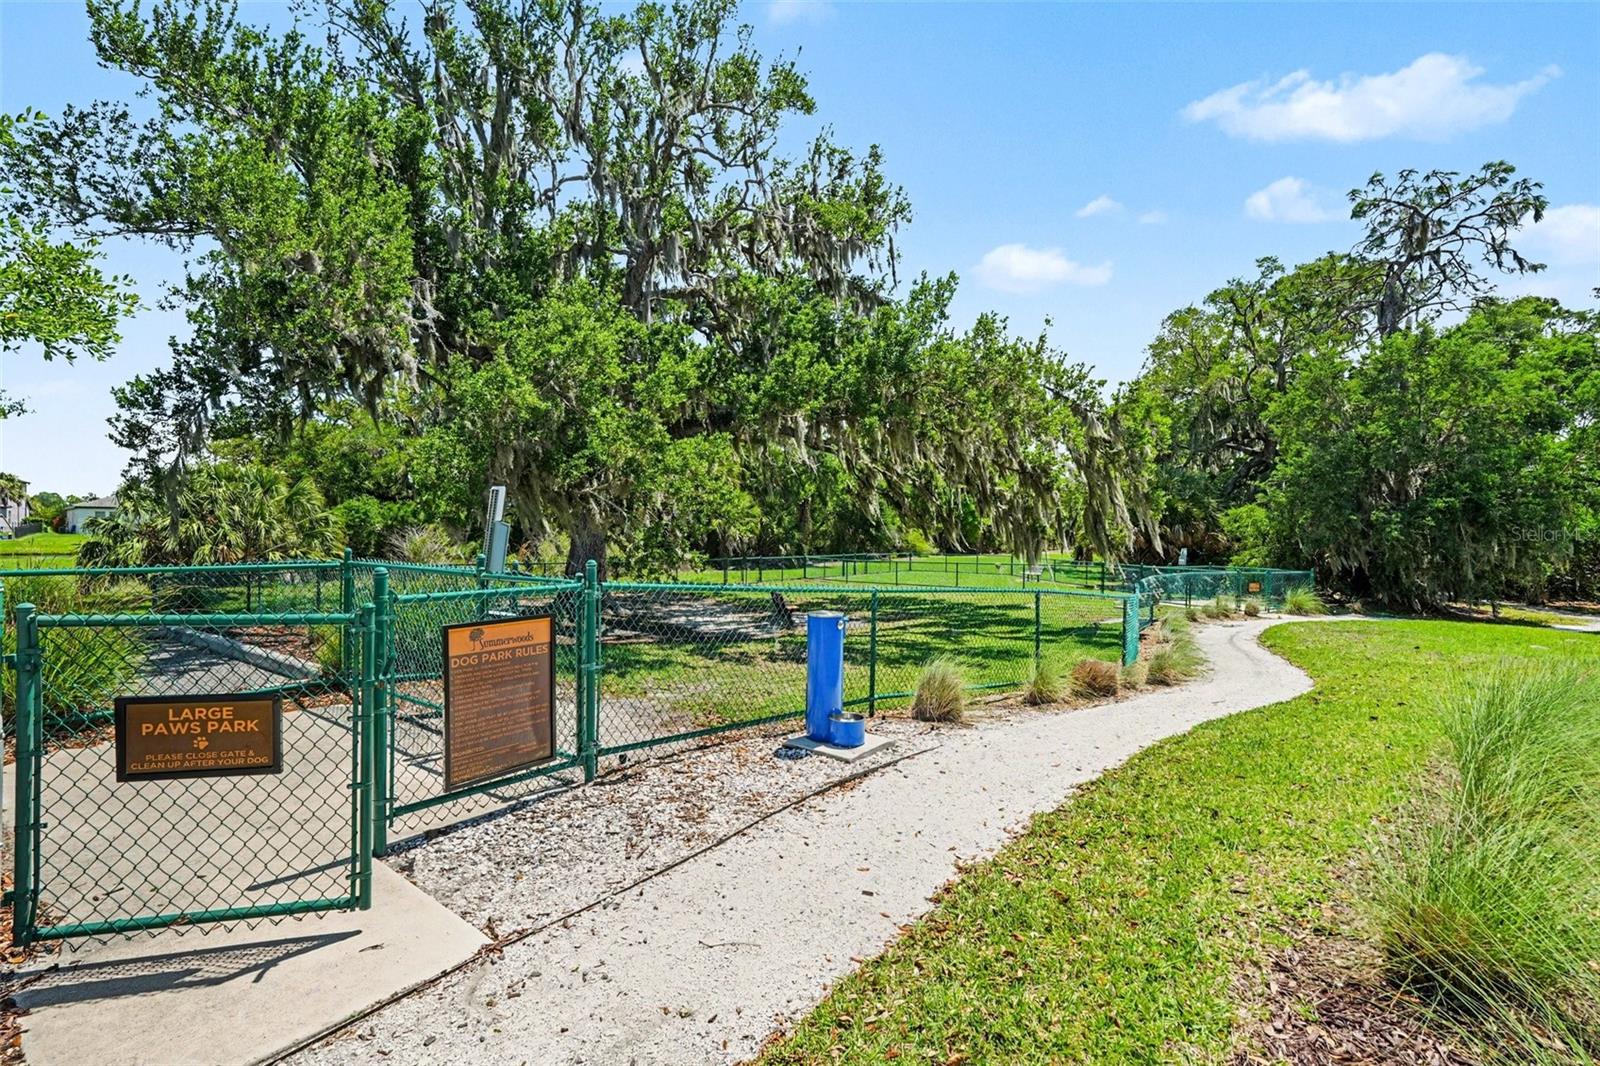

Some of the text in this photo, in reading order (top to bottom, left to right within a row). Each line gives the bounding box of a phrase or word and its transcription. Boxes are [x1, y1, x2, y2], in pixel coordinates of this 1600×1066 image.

[479, 632, 534, 650] Summerwoods
[451, 645, 549, 668] DOG PARK RULES
[168, 706, 234, 721] LARGE
[141, 719, 259, 736] PAWS PARK
[130, 756, 269, 770] CLEAN UP AFTER YOUR DOG
[145, 752, 183, 761] PLEASE
[185, 751, 218, 760] CLOSE
[220, 750, 247, 758] GATE
